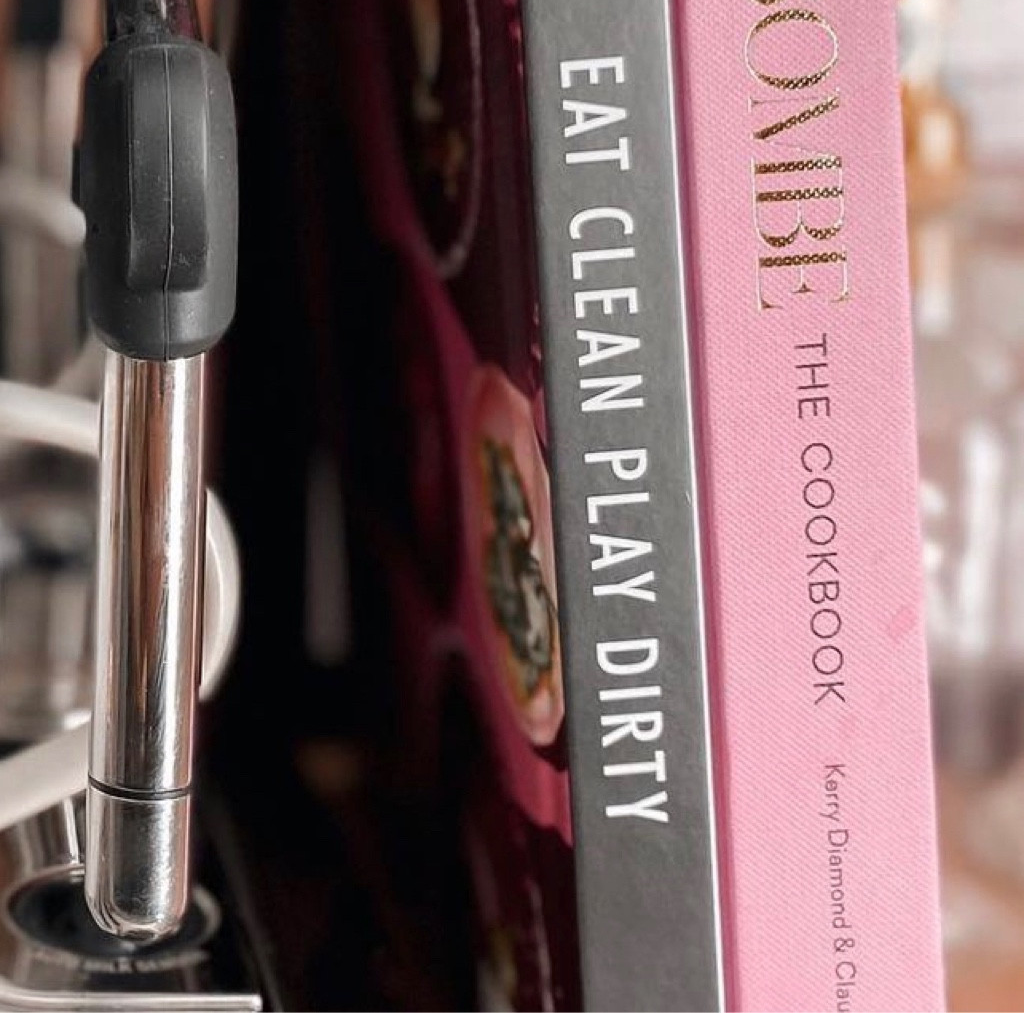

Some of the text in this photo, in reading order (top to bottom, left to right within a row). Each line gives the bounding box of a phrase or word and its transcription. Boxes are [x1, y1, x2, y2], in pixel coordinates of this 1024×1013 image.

[794, 333, 831, 420] THE
[559, 56, 669, 823] EAT CLEAN PLAY DIRTY
[800, 442, 846, 706] COOKBOOK
[819, 763, 846, 823] Kerry
[826, 828, 853, 929] Diamond
[833, 937, 856, 954] &
